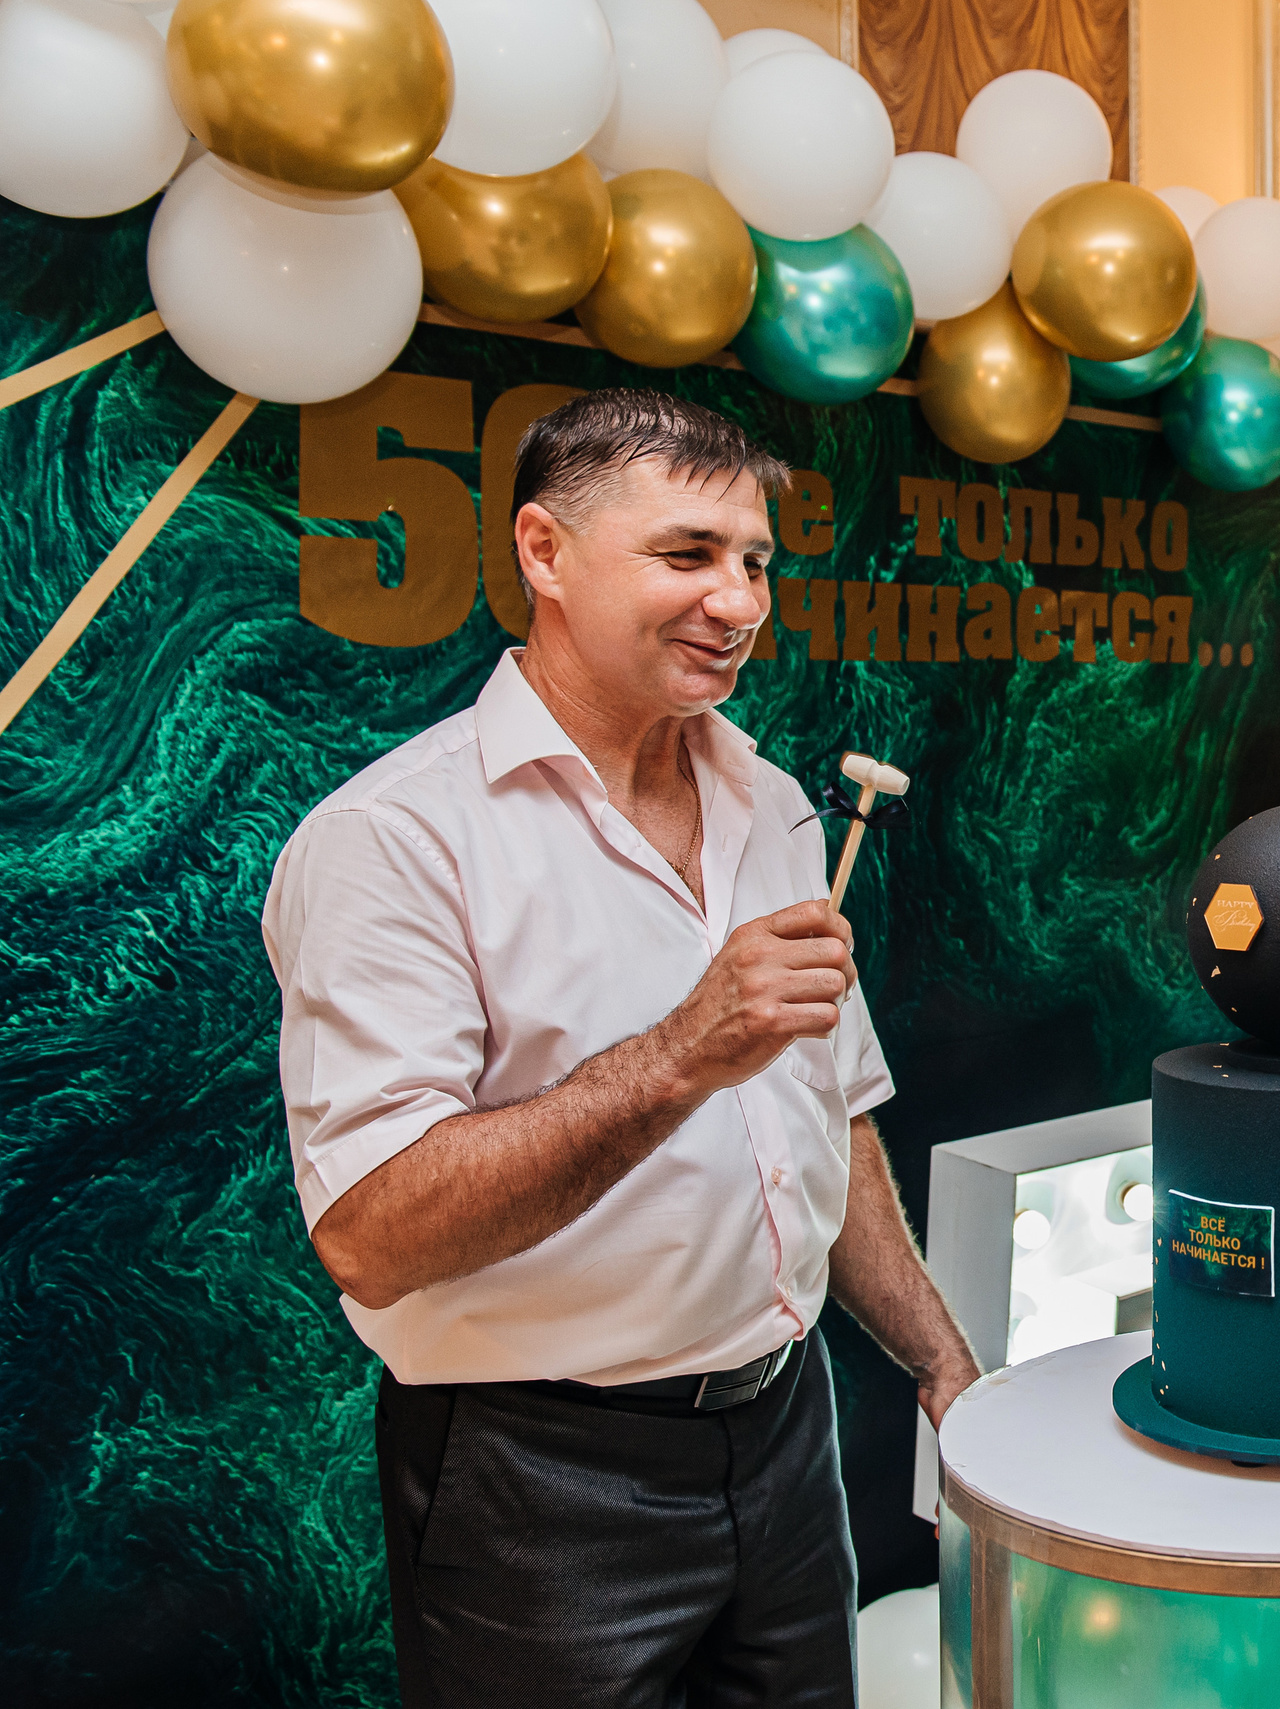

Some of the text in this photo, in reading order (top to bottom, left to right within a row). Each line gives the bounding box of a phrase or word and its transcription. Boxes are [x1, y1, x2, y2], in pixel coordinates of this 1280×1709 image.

[900, 475, 1188, 571] только
[1217, 899, 1254, 908] HAPPY
[1200, 1216, 1226, 1232] ВСЁ
[1188, 1228, 1241, 1251] ТОЛЬКО
